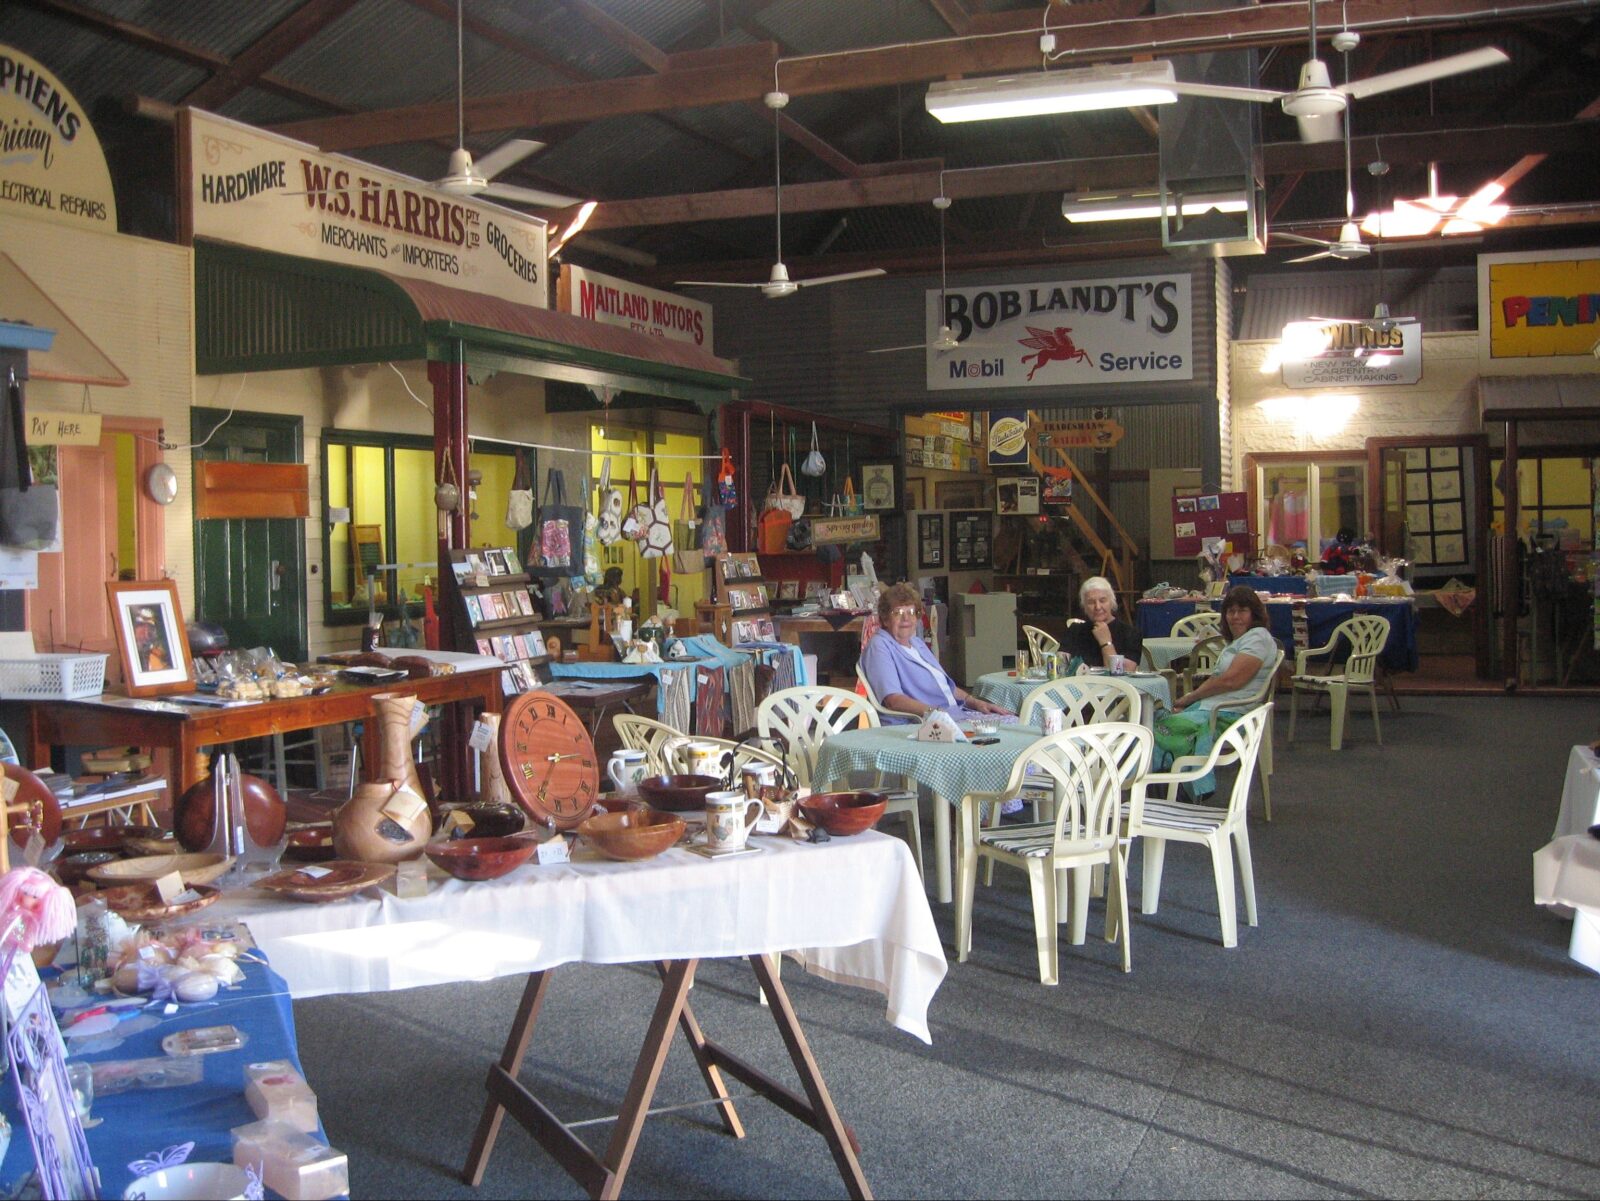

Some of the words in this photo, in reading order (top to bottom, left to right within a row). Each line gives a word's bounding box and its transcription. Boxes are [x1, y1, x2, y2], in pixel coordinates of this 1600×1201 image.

[0, 119, 54, 170] rician
[0, 180, 56, 211] ECTRICAL
[60, 194, 107, 221] REPAIRS
[202, 161, 286, 204] HARDWARE
[359, 177, 465, 246] HARRIS
[465, 209, 480, 226] PTY
[321, 223, 388, 259] MERCHANTS
[402, 243, 459, 275] IMPORTERS
[487, 221, 538, 284] GROCERIES
[580, 280, 649, 322] MAITLAND
[653, 300, 704, 346] MOTORS
[942, 292, 1021, 344] BOB
[1028, 281, 1179, 334] LANDT'S
[950, 358, 1004, 378] Mobil
[1100, 351, 1183, 372] Service
[1303, 375, 1351, 383] CABINET
[1354, 373, 1398, 382] MAKING
[1310, 359, 1338, 368] NEW
[1312, 367, 1381, 376] CARPENTRY
[32, 416, 49, 437] PAY
[58, 420, 82, 438] HERE
